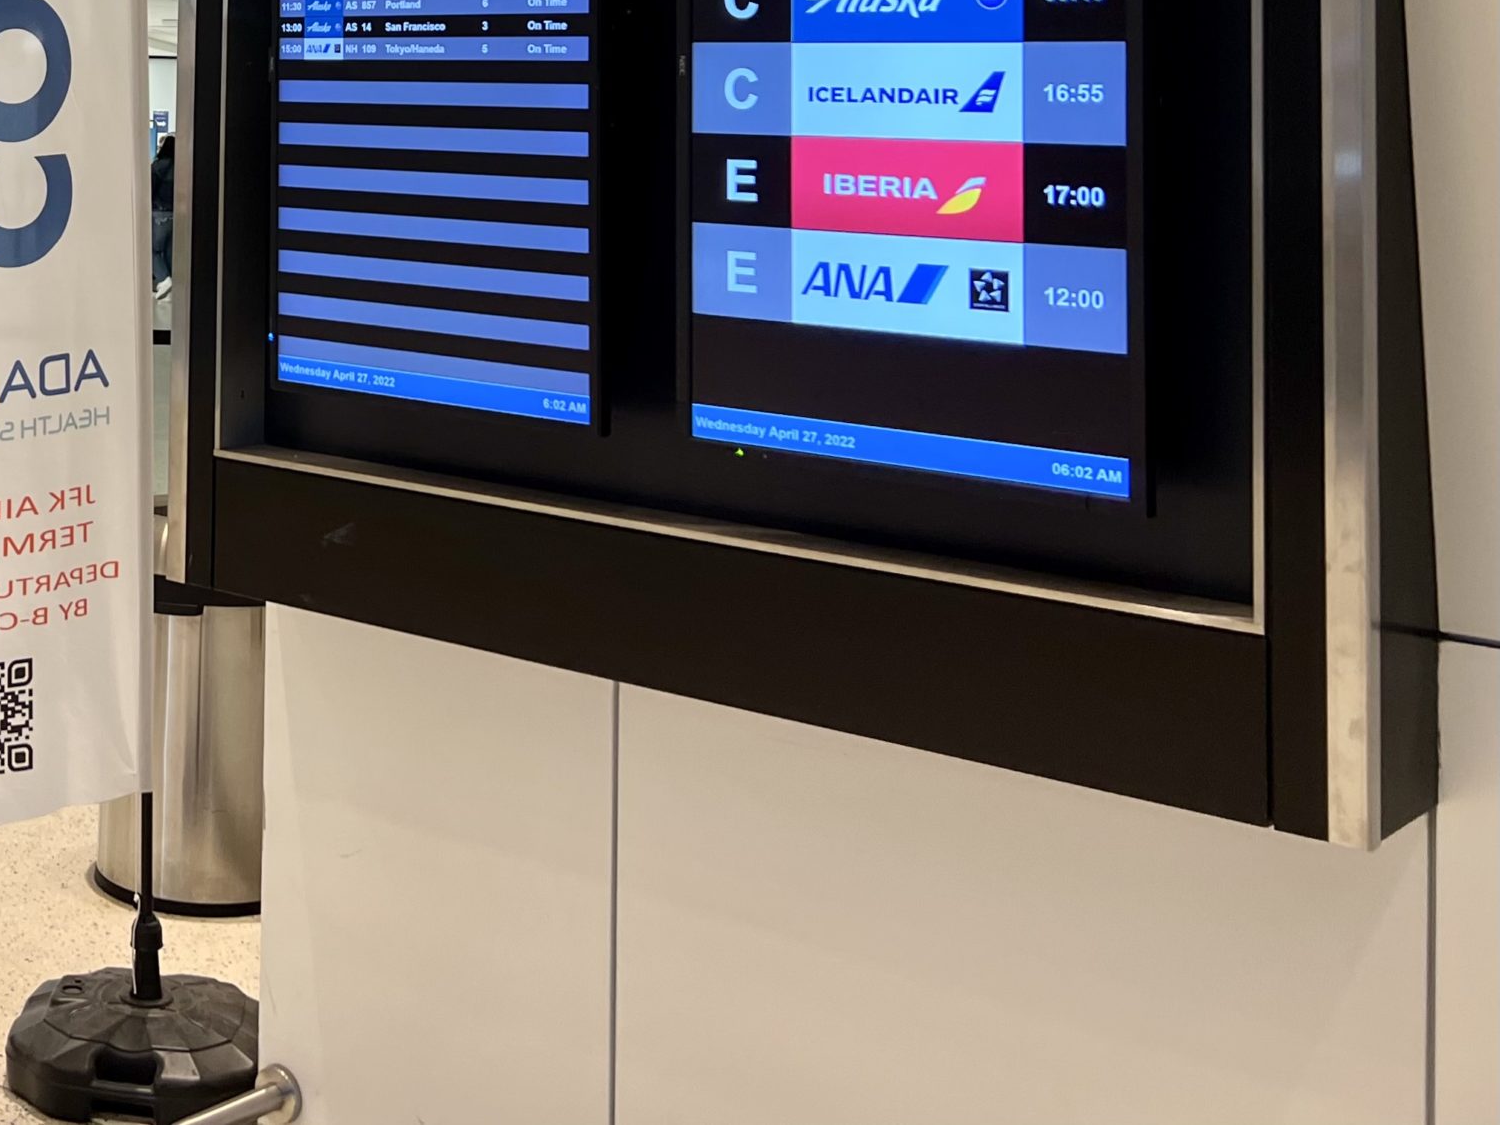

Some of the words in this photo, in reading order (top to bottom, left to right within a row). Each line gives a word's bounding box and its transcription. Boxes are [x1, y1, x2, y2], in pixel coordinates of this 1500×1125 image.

[345, 1, 358, 10] AS
[385, 0, 422, 9] Portland
[345, 23, 358, 31] AS
[385, 22, 402, 31] San
[403, 21, 446, 31] Francisco
[527, 21, 542, 31] On
[544, 20, 568, 31] Time
[345, 44, 358, 53] NH
[527, 44, 542, 53] On
[543, 44, 568, 53] Time
[724, 68, 758, 109] C
[808, 86, 958, 105] ICELANDAIR
[1043, 83, 1103, 103] 16:55
[726, 159, 758, 202] E
[823, 174, 937, 200] IBERIA
[1043, 185, 1105, 207] 17:00
[727, 250, 757, 293] E
[801, 261, 893, 302] ANA
[1044, 288, 1104, 308] 12:00
[280, 361, 330, 380] Wednesday
[333, 368, 354, 383] April
[356, 372, 371, 385] 27,
[373, 375, 396, 388] 2022
[543, 398, 566, 411] 6:02
[568, 401, 586, 413] AM
[696, 415, 766, 440] Wednesday
[769, 424, 799, 444] April
[802, 430, 822, 446] 27,
[824, 432, 855, 449] 2022
[1052, 463, 1093, 480] 06:02
[1096, 466, 1122, 484] AM
